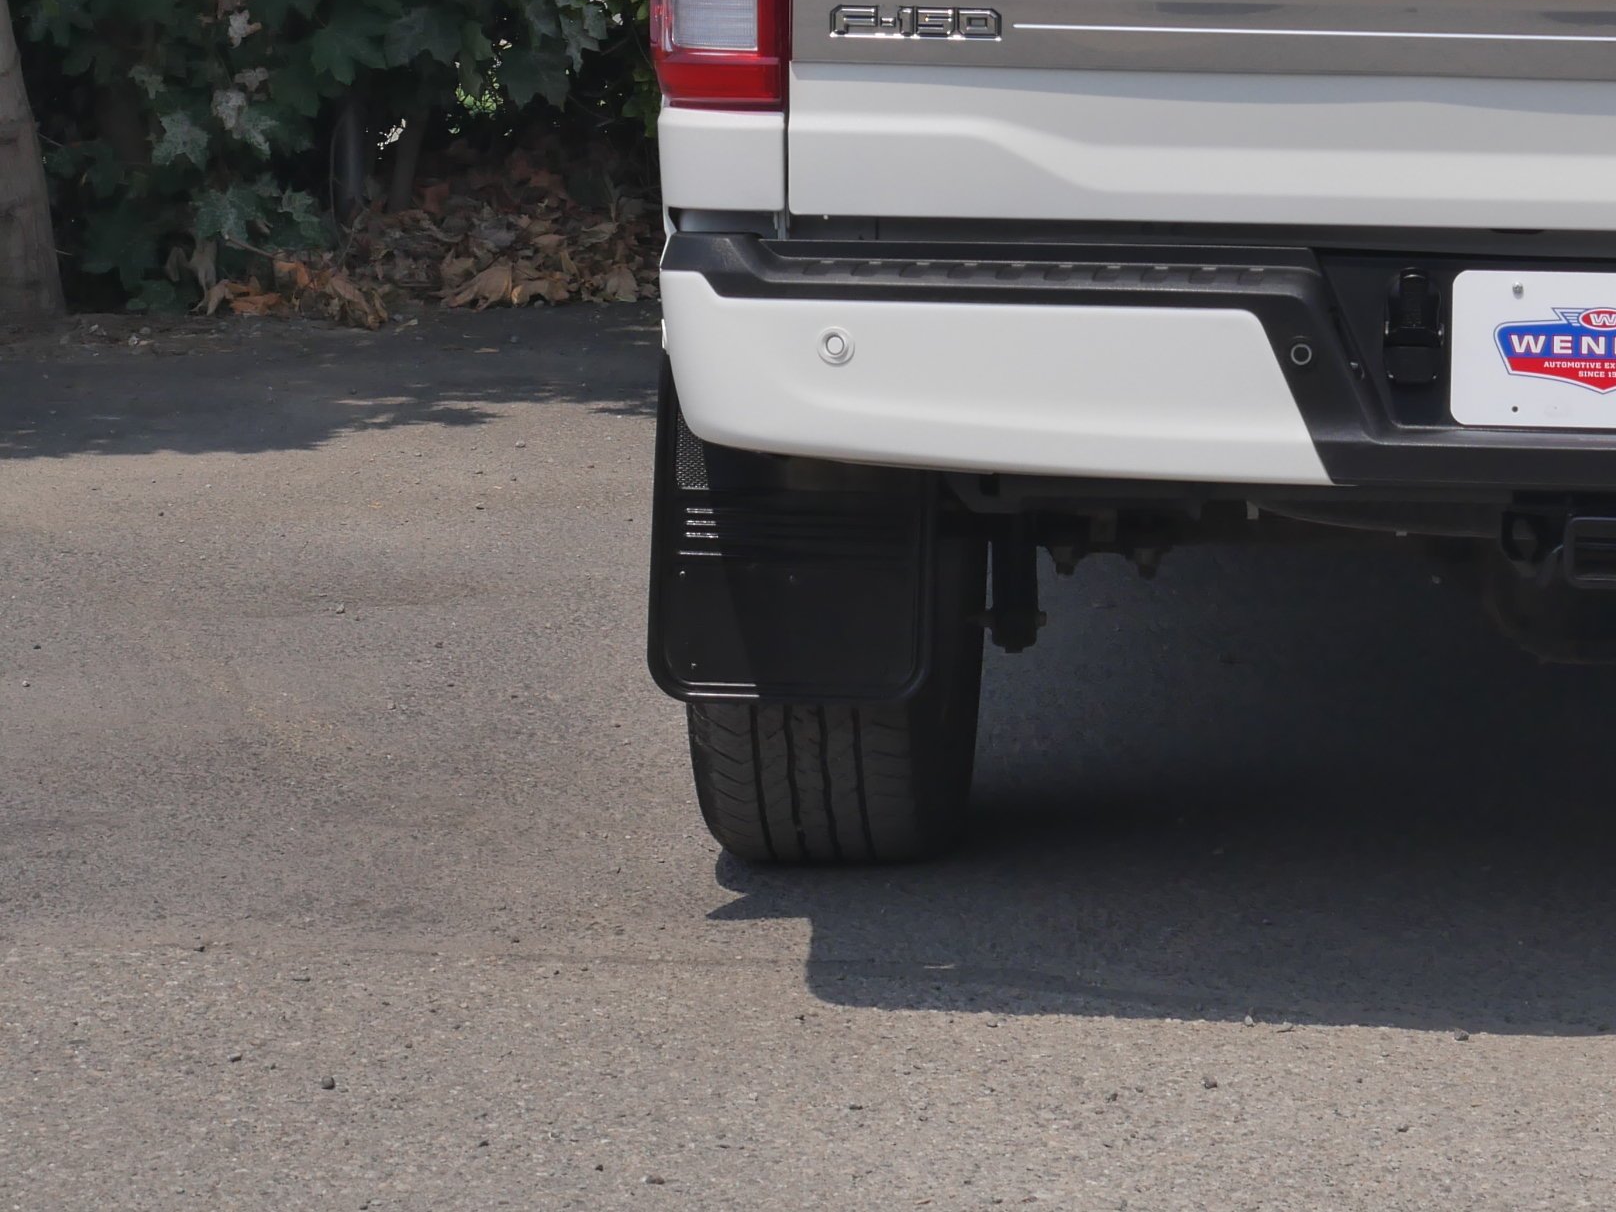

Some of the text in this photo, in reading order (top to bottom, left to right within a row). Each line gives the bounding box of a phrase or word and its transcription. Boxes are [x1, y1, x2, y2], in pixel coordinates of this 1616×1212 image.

[829, 4, 1003, 42] F-150
[1544, 361, 1601, 369] AUTOMOTIVE
[1578, 370, 1606, 378] SINCE
